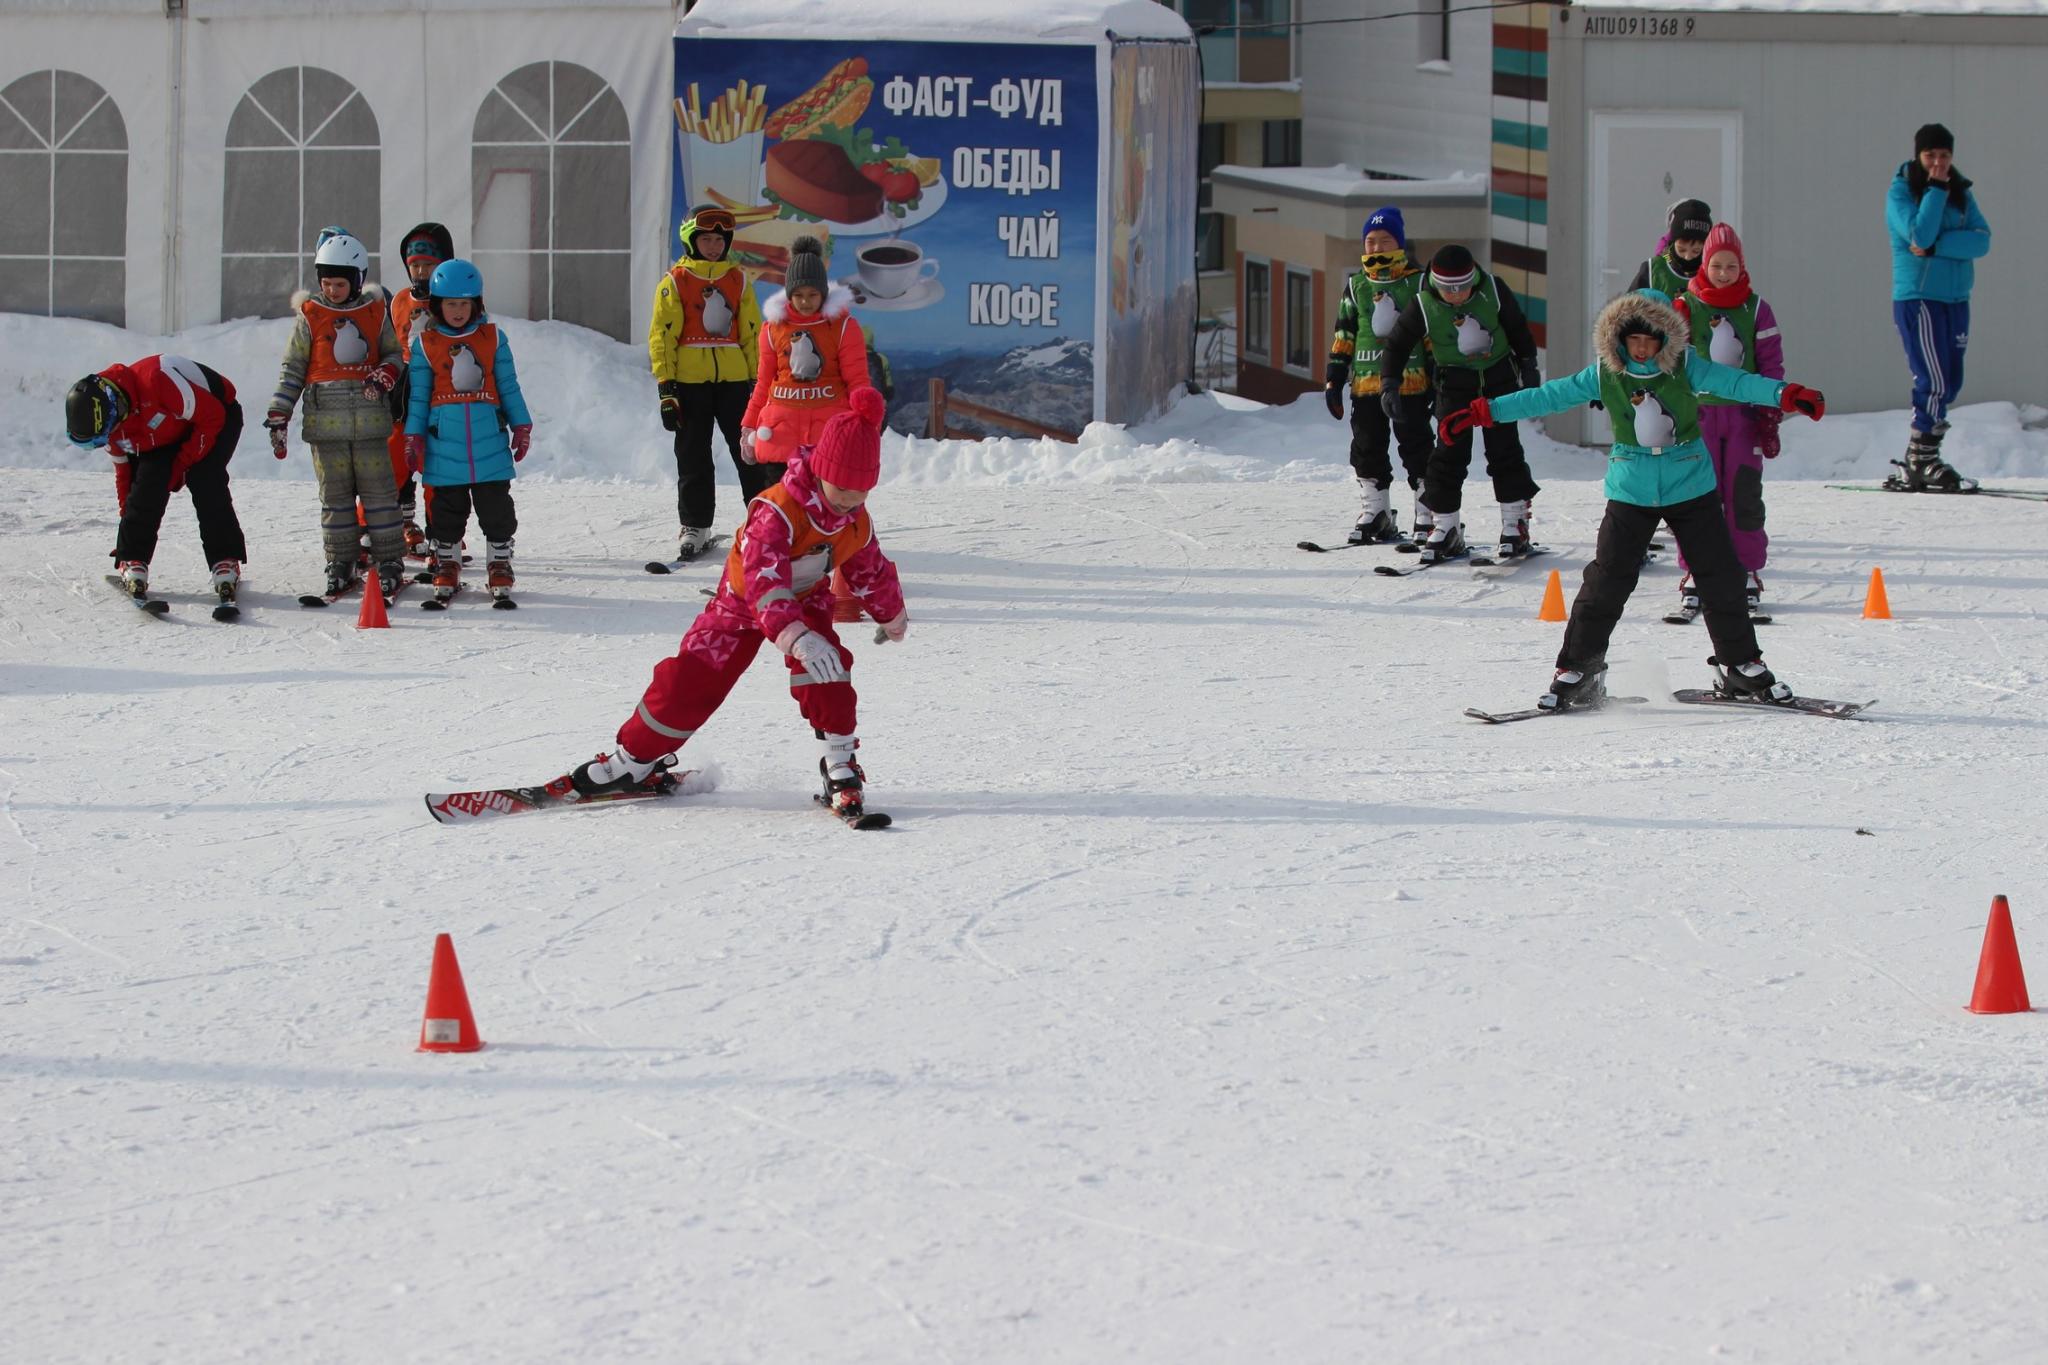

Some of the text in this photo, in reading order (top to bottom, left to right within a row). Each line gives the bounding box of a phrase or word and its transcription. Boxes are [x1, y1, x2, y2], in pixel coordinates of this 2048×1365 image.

[1685, 17, 1695, 36] 9
[883, 75, 1063, 126] ФАСТ-ФУД
[952, 146, 1061, 196] ОБЕДЫ
[998, 209, 1060, 258] ЧАЙ
[969, 283, 1059, 326] КОФЕ
[773, 385, 835, 400] ШИГЛС
